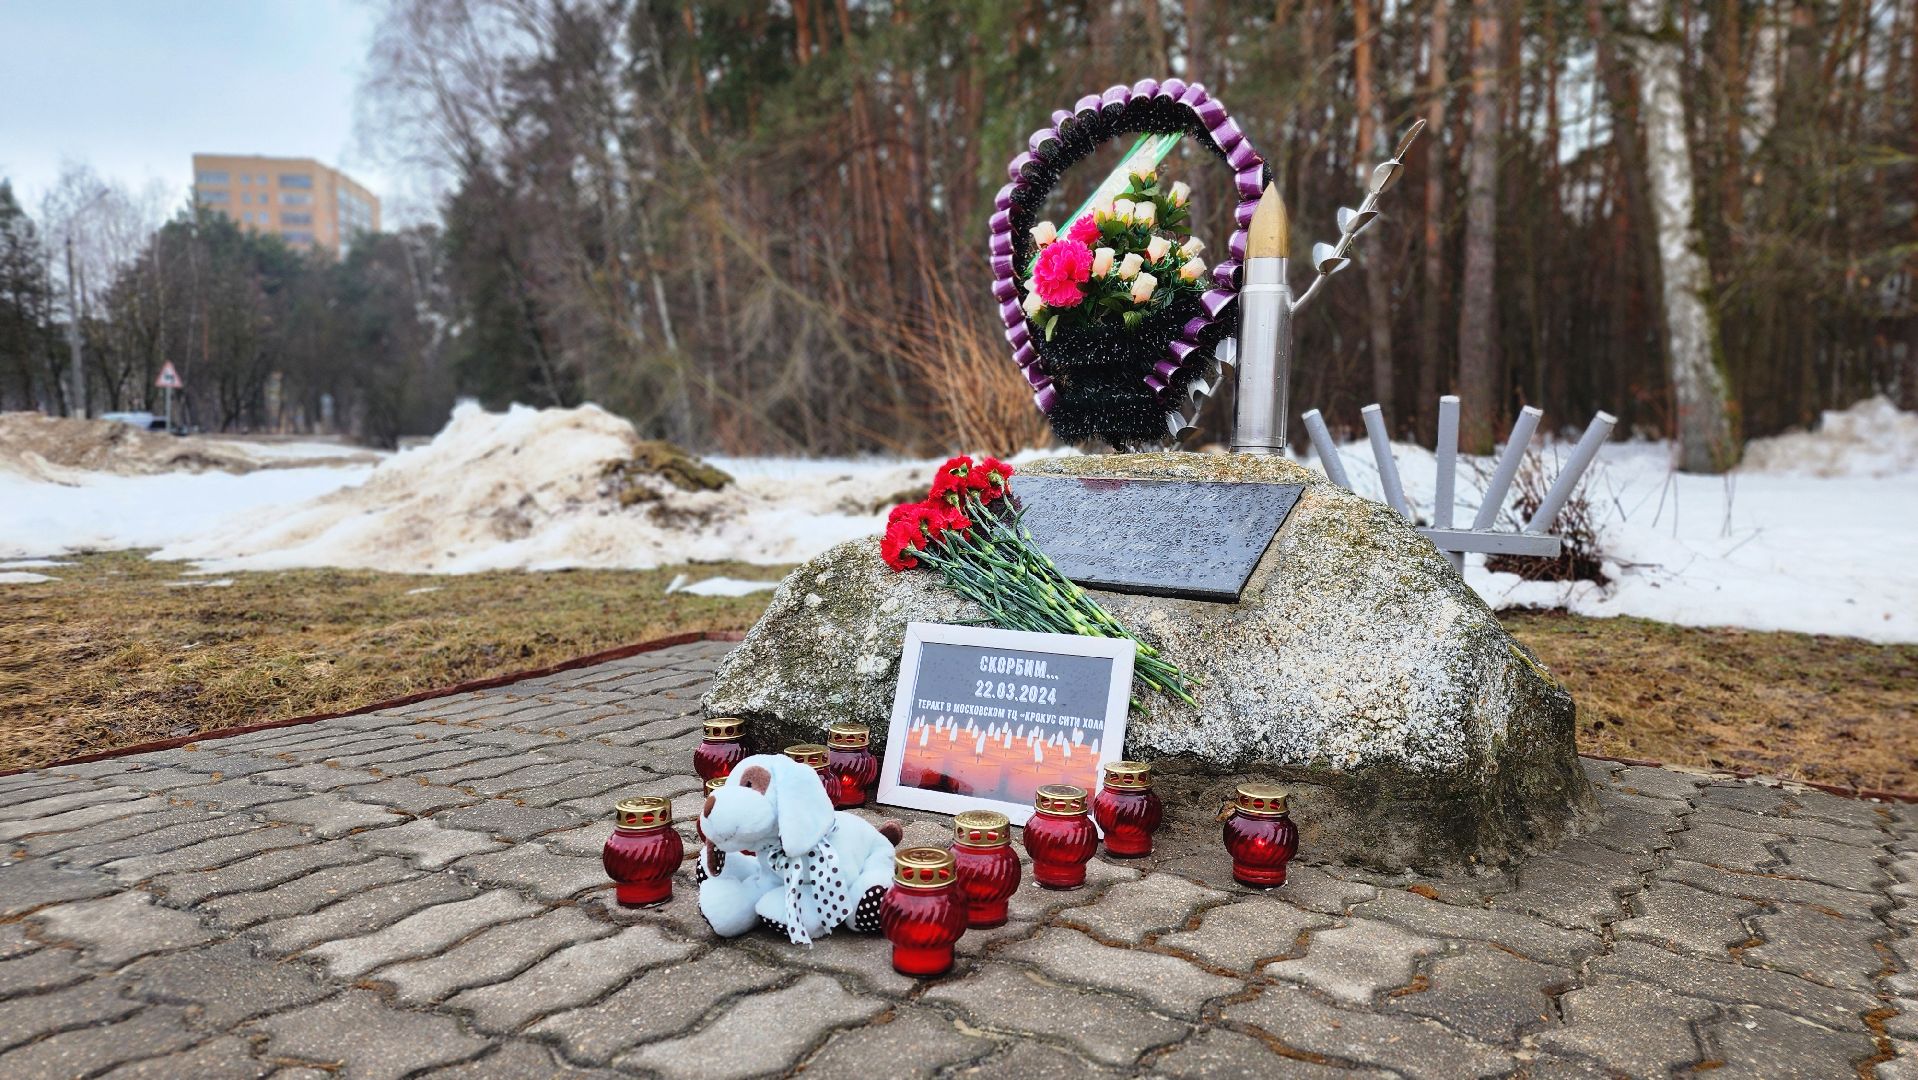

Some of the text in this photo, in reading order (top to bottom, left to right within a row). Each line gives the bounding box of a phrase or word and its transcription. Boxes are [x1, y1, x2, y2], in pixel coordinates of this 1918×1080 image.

[979, 655, 1059, 680] СКОРБИМ...
[974, 680, 1057, 705] 22.03.2024
[918, 698, 945, 712] ТЕРАКТ
[946, 702, 953, 712] В
[953, 703, 1005, 719] МОСКОВСКОМ
[1007, 709, 1018, 722] ТЦ
[1058, 715, 1081, 729] СИТИ
